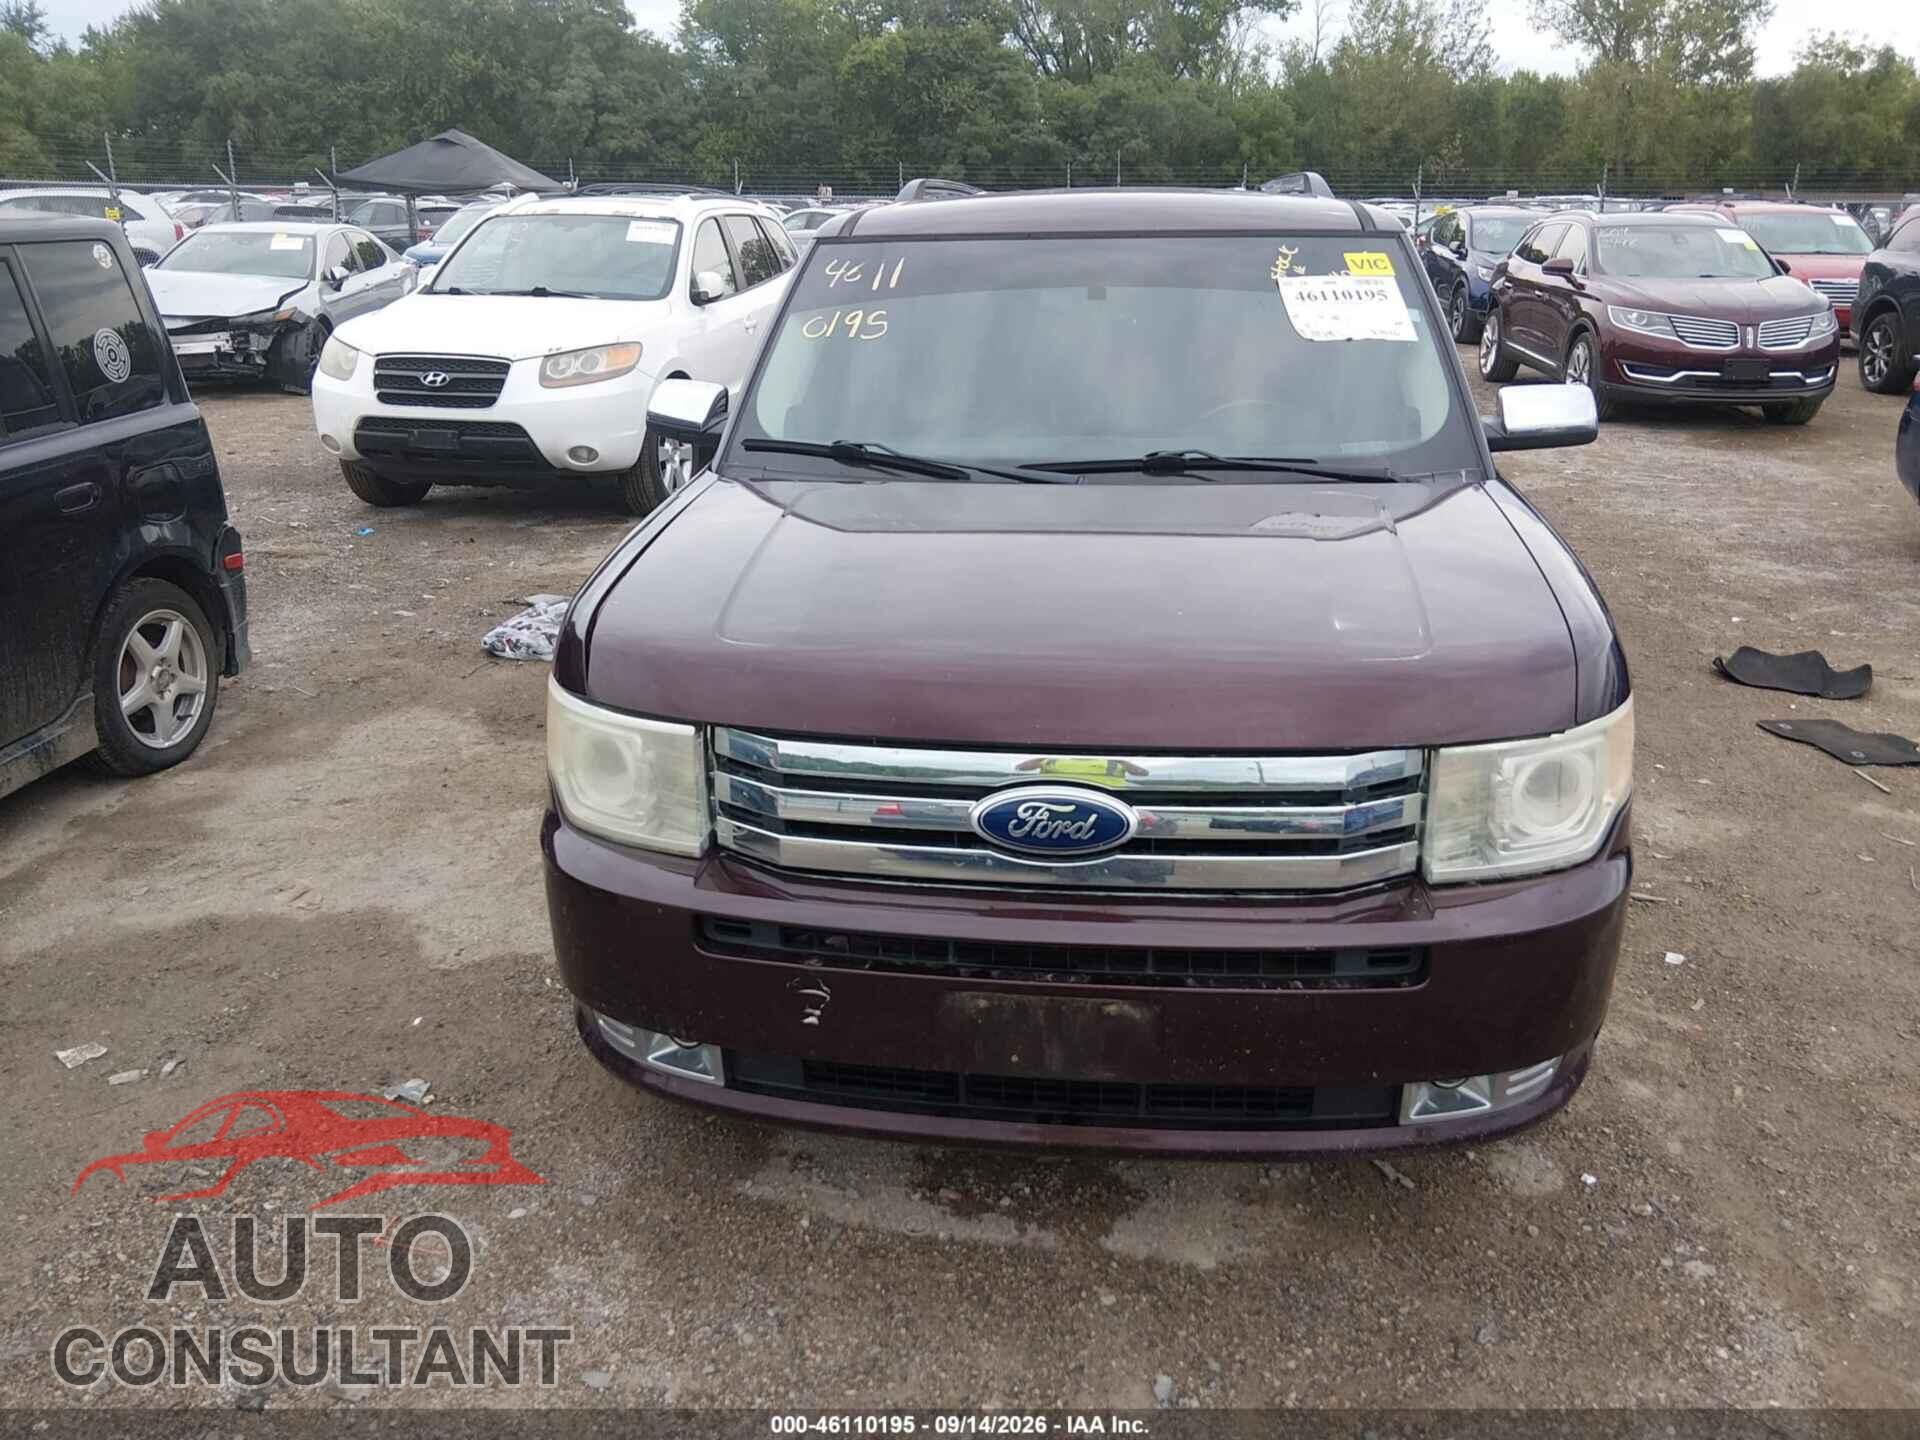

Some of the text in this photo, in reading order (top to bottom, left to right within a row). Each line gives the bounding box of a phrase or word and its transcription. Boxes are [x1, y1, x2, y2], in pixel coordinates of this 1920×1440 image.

[824, 256, 905, 291] 4611
[1350, 257, 1389, 270] VIC
[1295, 288, 1389, 303] 46110195
[802, 309, 888, 340] 0195
[1007, 801, 1098, 840] Ford
